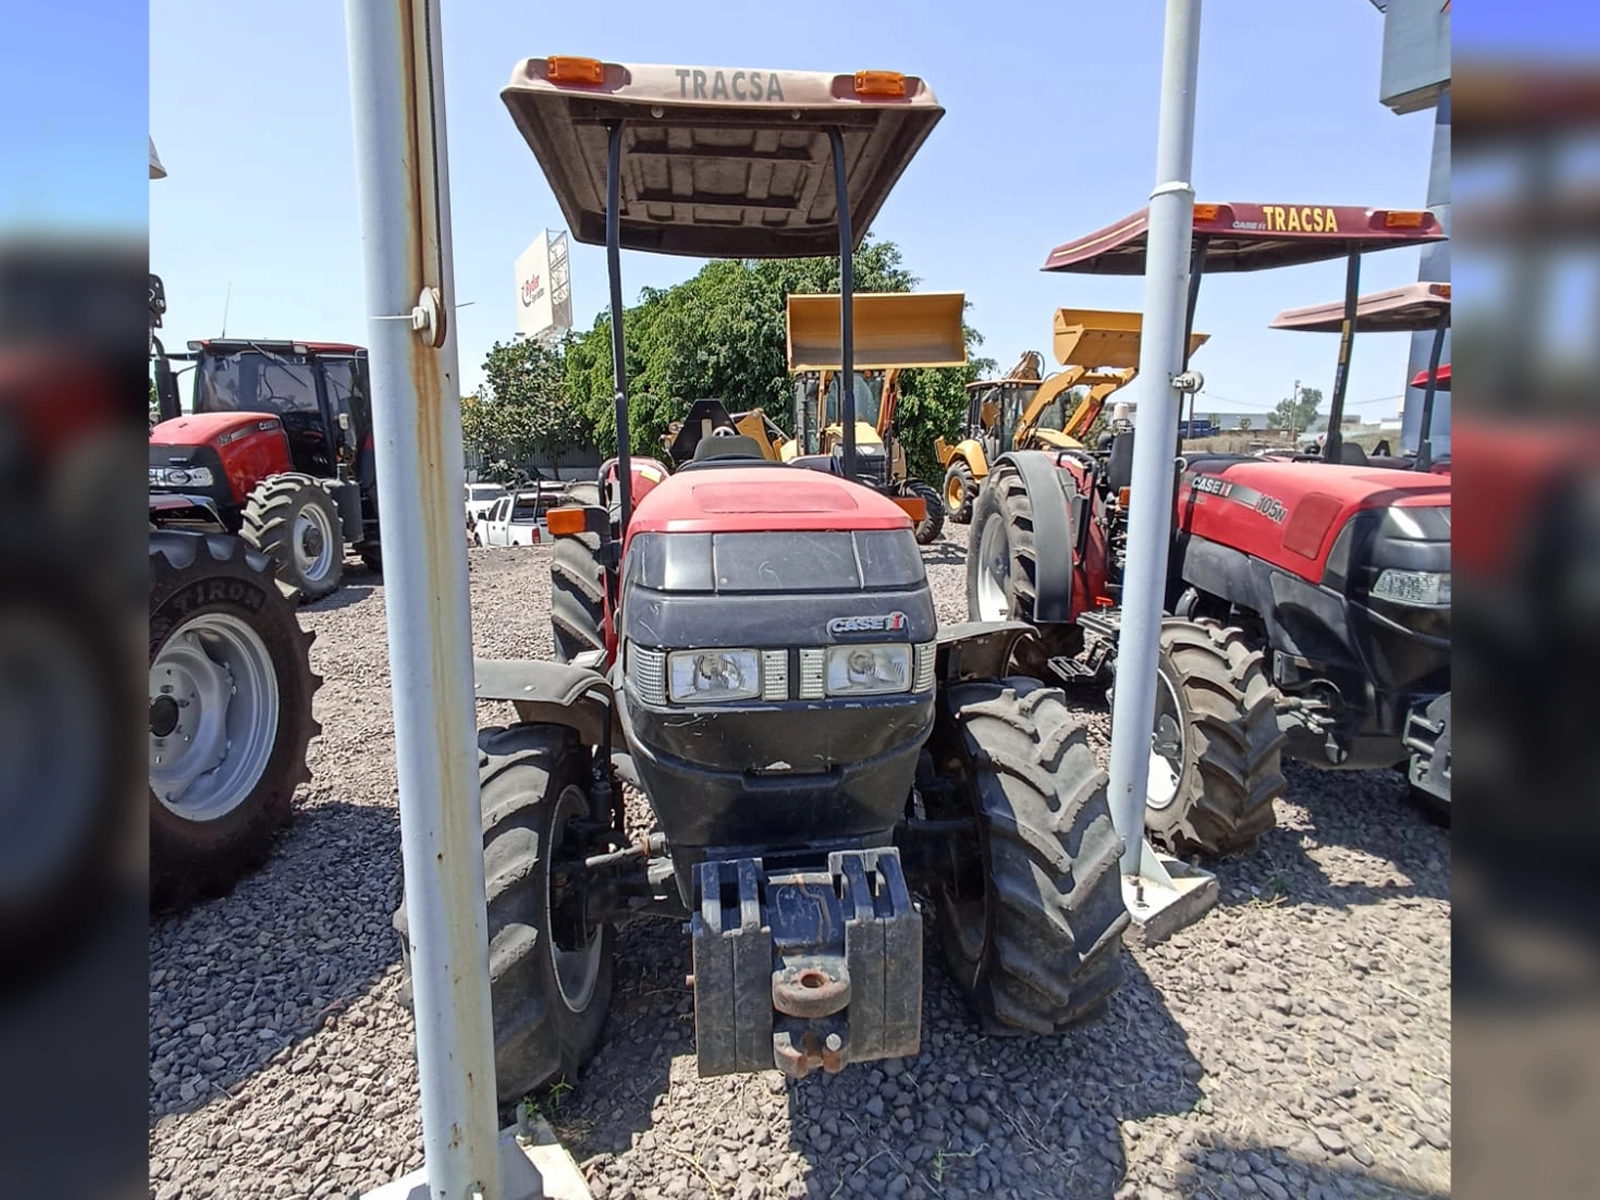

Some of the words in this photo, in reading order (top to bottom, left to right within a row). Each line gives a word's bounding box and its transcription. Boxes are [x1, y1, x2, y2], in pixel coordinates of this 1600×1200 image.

[675, 69, 784, 102] TRACSA
[1262, 206, 1338, 232] TRACSA
[1191, 476, 1221, 495] CASE
[1256, 494, 1288, 524] 105N
[832, 618, 884, 633] CASE
